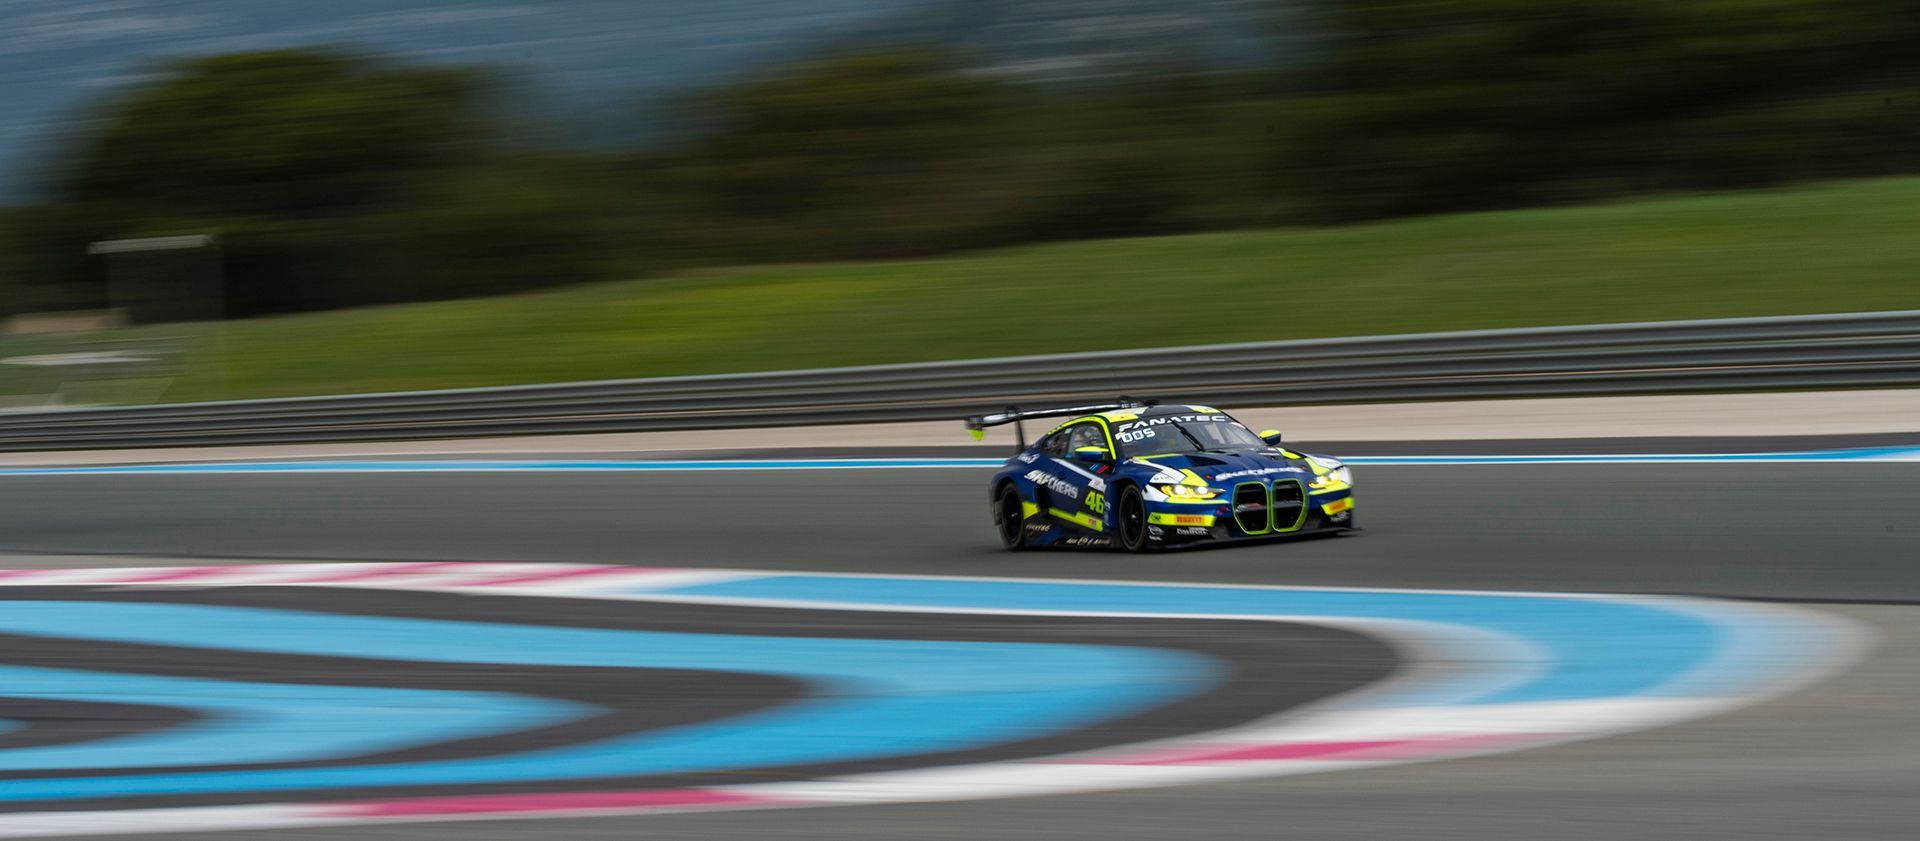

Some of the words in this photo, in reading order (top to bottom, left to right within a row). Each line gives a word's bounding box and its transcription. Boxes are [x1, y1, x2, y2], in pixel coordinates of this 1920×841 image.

[1118, 415, 1226, 432] FANATEC
[1024, 470, 1079, 499] SKECHERS
[1085, 490, 1104, 514] 46
